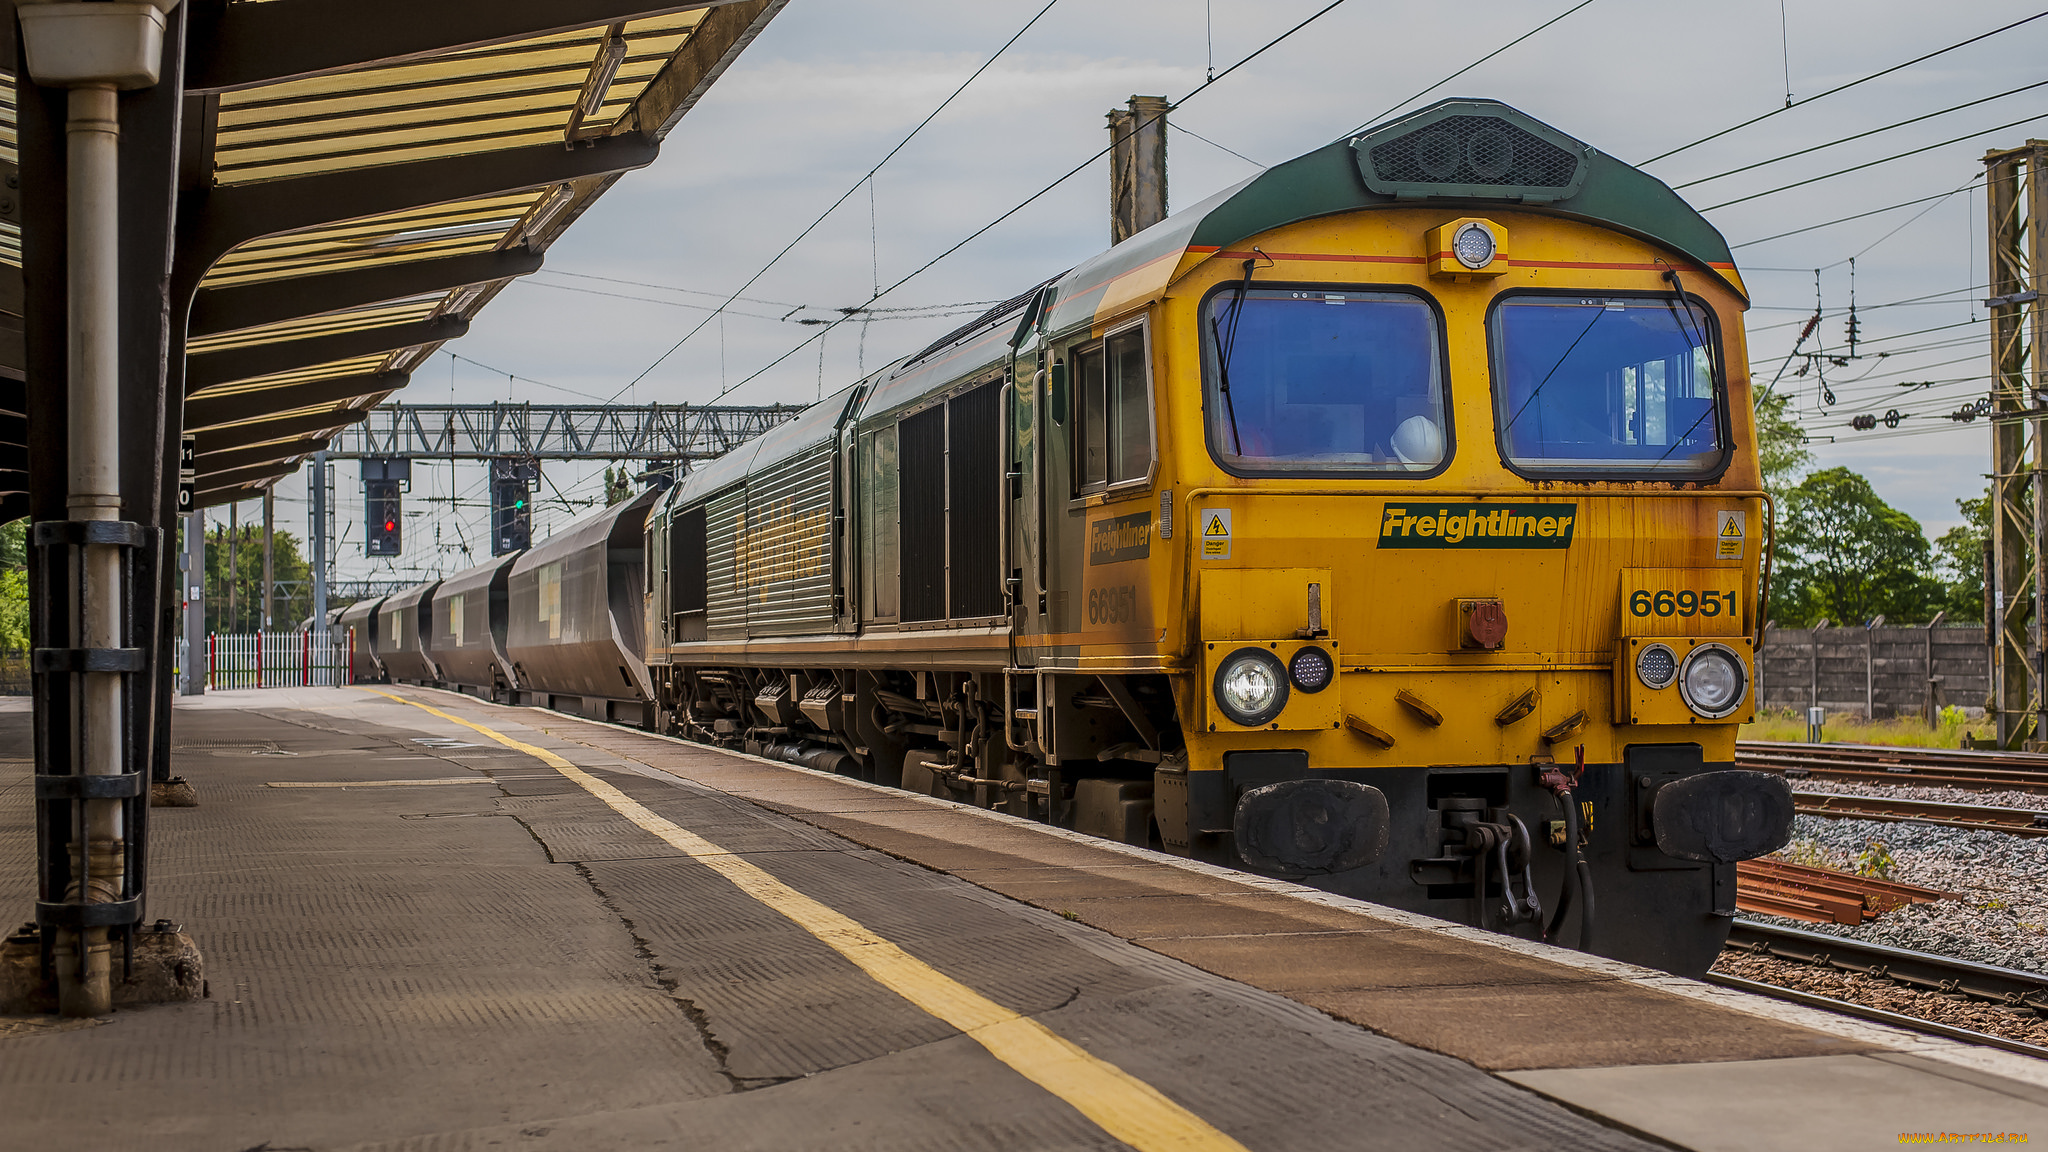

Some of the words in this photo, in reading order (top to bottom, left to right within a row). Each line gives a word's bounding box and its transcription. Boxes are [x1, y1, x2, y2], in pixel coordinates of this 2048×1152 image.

[1092, 521, 1150, 557] Freightliner
[1382, 508, 1572, 543] Freightliner
[1089, 585, 1136, 625] 66951
[1630, 589, 1736, 617] 66951
